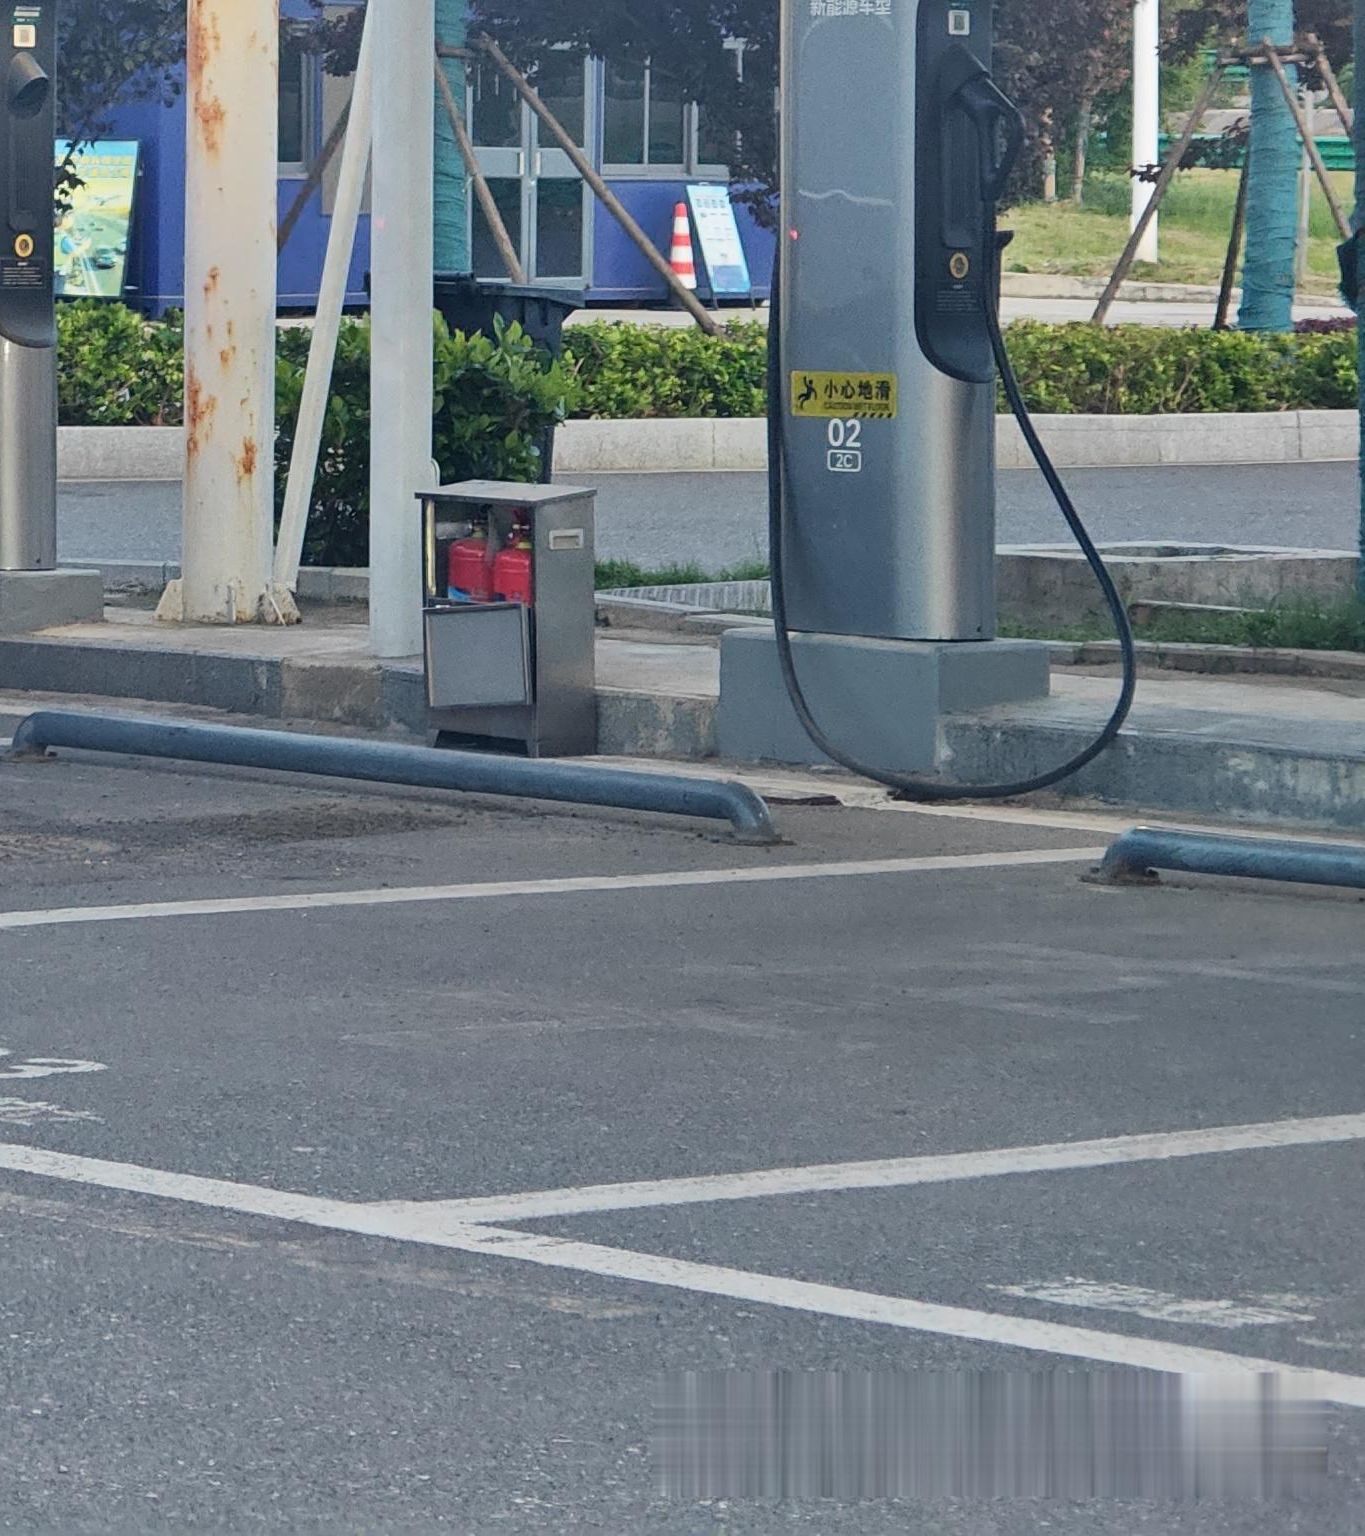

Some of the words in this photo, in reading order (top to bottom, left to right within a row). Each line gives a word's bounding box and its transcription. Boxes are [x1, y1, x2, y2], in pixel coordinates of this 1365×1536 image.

[824, 379, 890, 401] 小心地滑
[828, 418, 861, 448] 02
[835, 454, 853, 468] 2C
